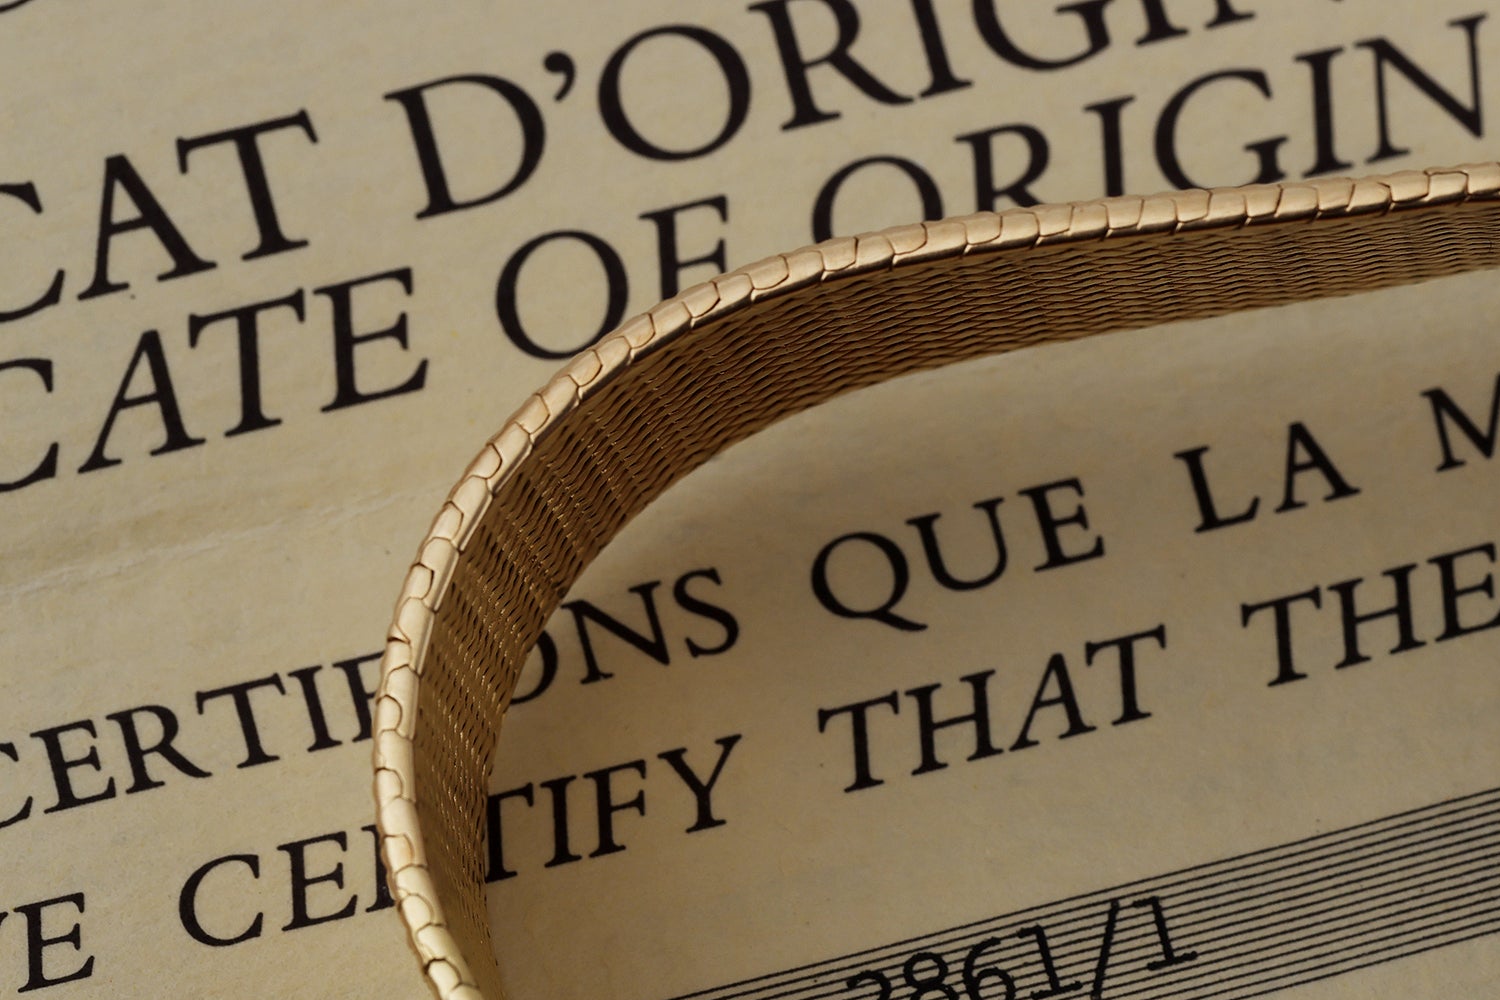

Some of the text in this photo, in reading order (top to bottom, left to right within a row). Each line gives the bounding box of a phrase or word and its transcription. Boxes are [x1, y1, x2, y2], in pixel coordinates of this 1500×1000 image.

[382, 0, 1257, 220] D'ORIG
[496, 195, 730, 361] OF
[811, 11, 1489, 246] ORIGIN
[0, 567, 740, 829] ERTIFNS
[810, 476, 1106, 632] QUE
[1173, 420, 1361, 534] LA
[0, 892, 95, 994] E
[817, 624, 1167, 793] THAT
